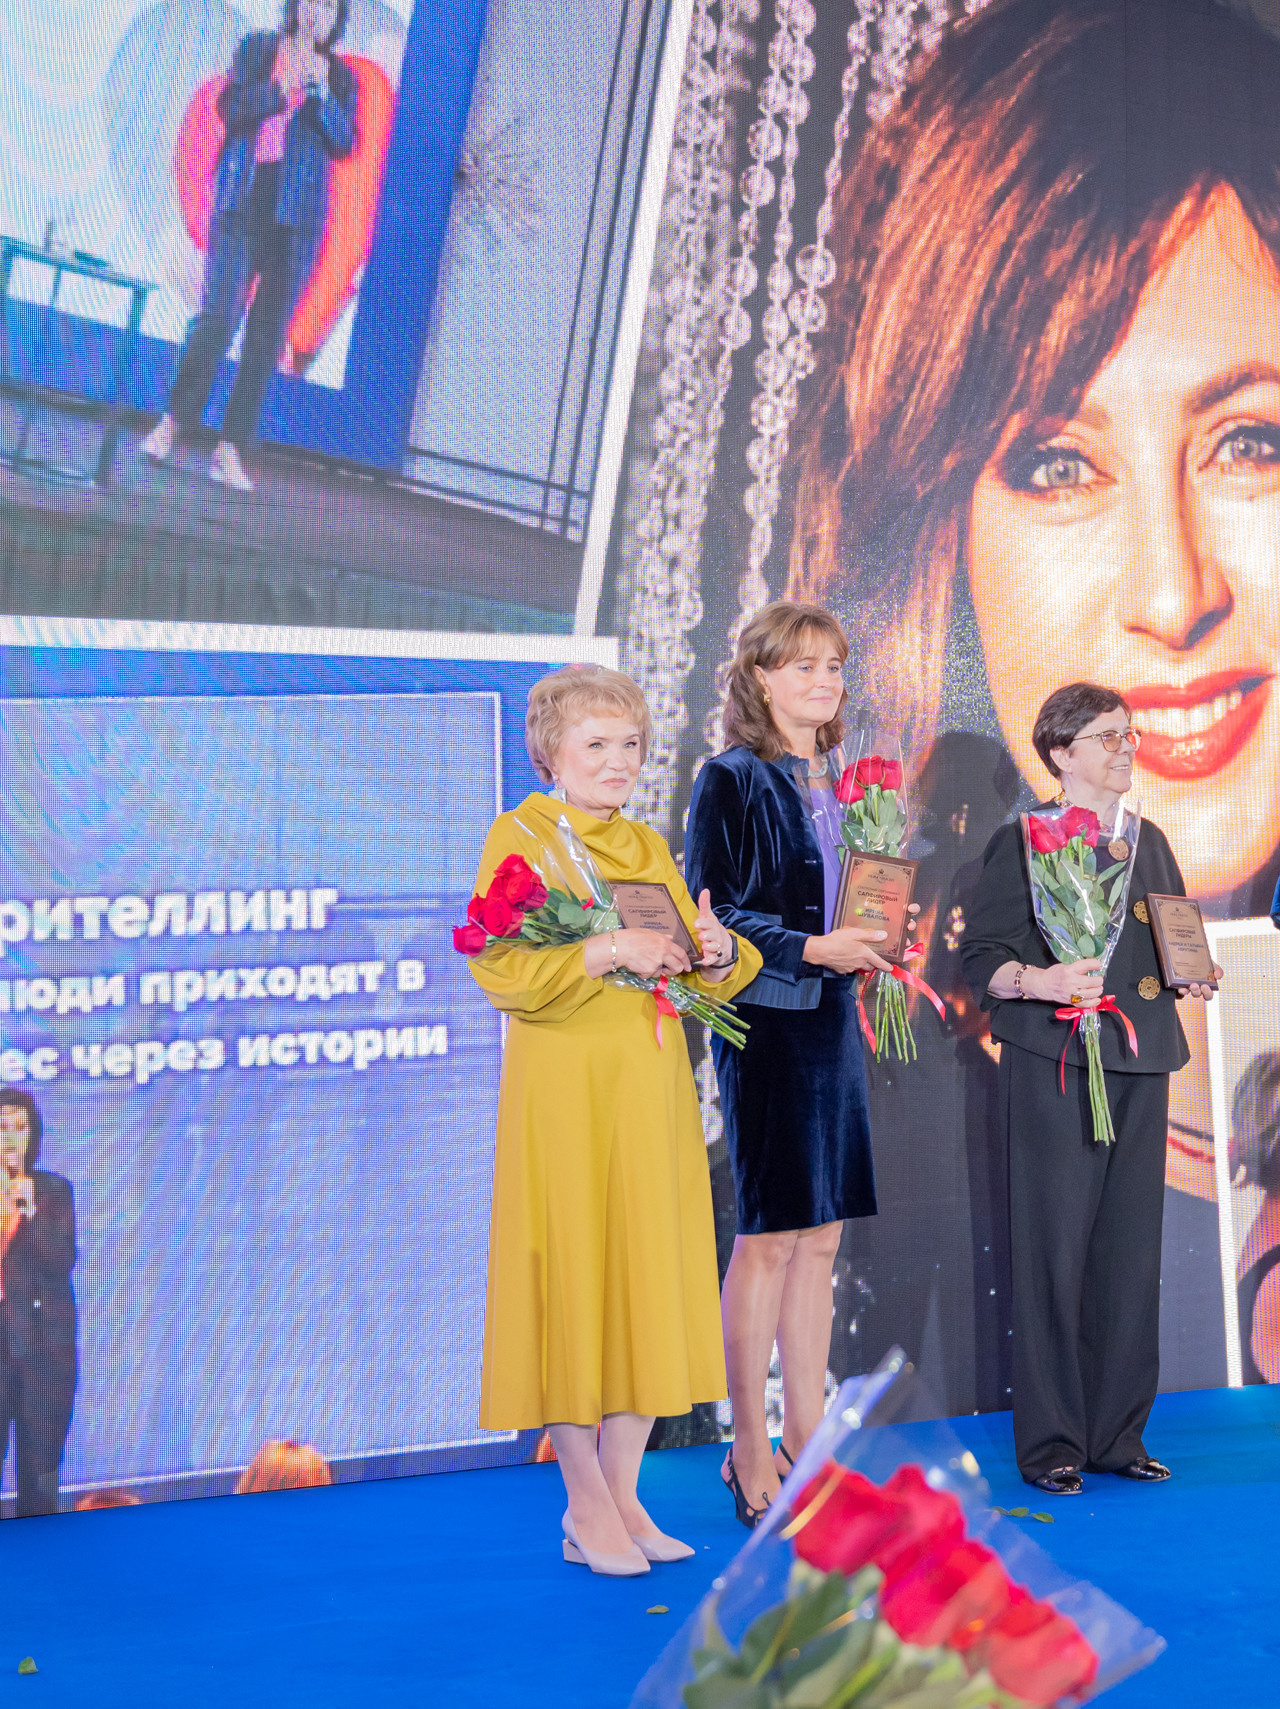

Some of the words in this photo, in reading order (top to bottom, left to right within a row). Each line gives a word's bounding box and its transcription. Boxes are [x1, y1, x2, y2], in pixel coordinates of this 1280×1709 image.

[857, 891, 898, 902] САПФИРОВЫЙ
[139, 960, 385, 1011] приходят
[396, 958, 426, 991] в
[71, 1038, 225, 1084] через
[238, 1025, 448, 1070] истории
